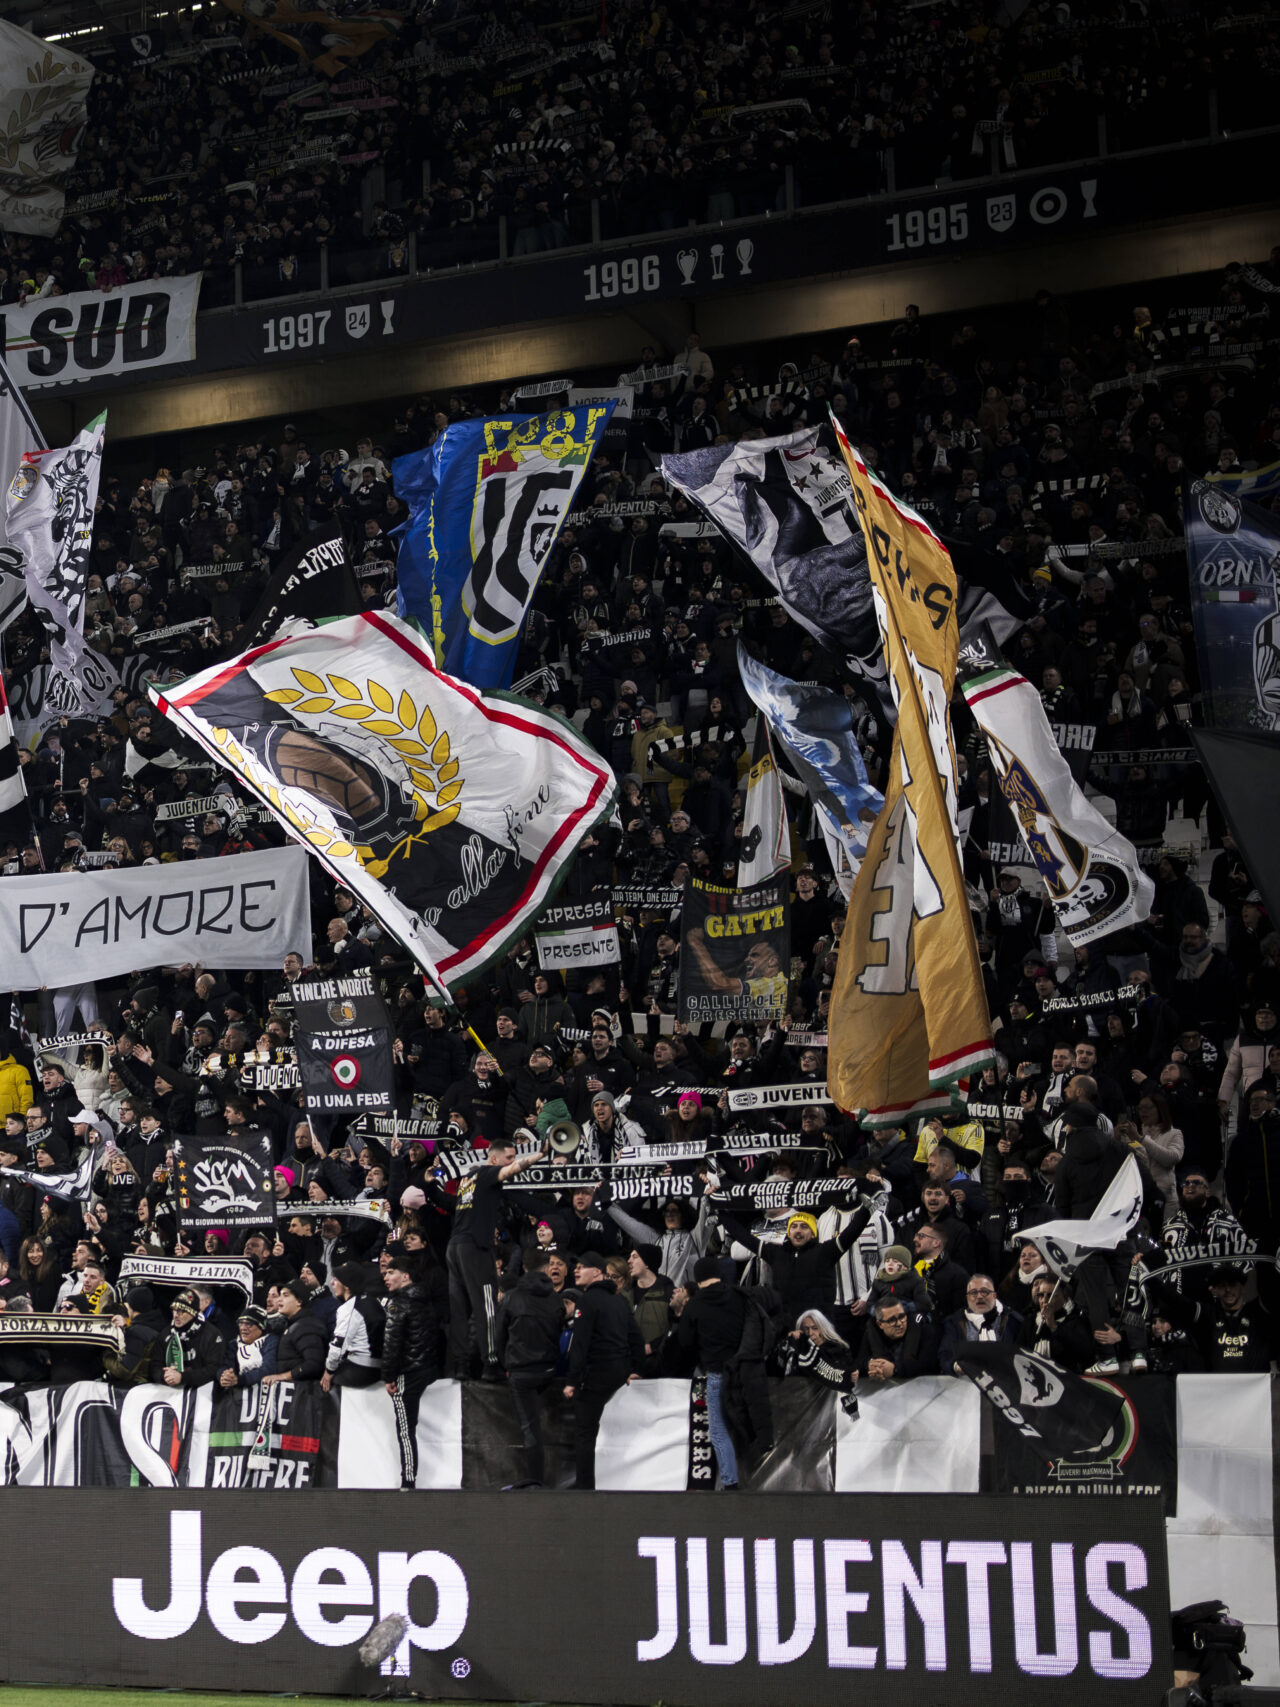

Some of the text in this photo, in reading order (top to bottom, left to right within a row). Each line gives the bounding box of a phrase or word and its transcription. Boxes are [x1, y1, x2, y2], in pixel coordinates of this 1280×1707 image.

[885, 202, 1014, 252] 1995 23
[584, 254, 660, 301] 1996
[26, 292, 171, 376] SUD
[263, 309, 368, 353] 1997 24
[814, 475, 851, 507] JUVENTUS
[602, 500, 655, 515] JUVENTUS
[821, 498, 861, 536] 7
[222, 561, 245, 573] JUVE
[1199, 559, 1255, 587] OBN
[1138, 750, 1190, 763] SIAMO
[164, 795, 218, 818] JUVENTUS
[446, 784, 551, 909] alla fine
[692, 877, 699, 888] IN
[623, 890, 679, 903] TEAM, ONE CLUB
[732, 887, 780, 909] LEONI
[19, 878, 277, 955] D'AMORE
[704, 906, 785, 938] GATTI
[542, 937, 616, 960] PRESENTE
[337, 977, 376, 997] MORTE
[686, 994, 785, 1010] GALLIPOLI
[689, 1010, 783, 1023] PRESENTE
[792, 1022, 811, 1032] 1897
[311, 1035, 376, 1051] A DIFESA
[306, 1091, 391, 1108] DI UNA FEDE
[373, 1117, 443, 1136] FINO ALLA FINE
[649, 1142, 679, 1158] FINO
[722, 1132, 801, 1149] JUVENTUS
[224, 1146, 241, 1156] OFFICIAL
[193, 1154, 257, 1190] SGM
[550, 1165, 604, 1181] ALLA
[609, 1175, 694, 1201] JUVENTUS
[730, 1176, 857, 1197] DI PADRE IN FIGLIO
[754, 1190, 823, 1209] SINCE 1897
[181, 1215, 274, 1227] SAN GIOVANNI IN MARIGNANO
[1165, 1237, 1259, 1264] JUVENTUS
[130, 1262, 241, 1279] MICHEL PLATINI
[1, 1317, 94, 1333] FORZA JUVE
[1218, 1333, 1249, 1348] Jeep
[814, 1356, 846, 1384] JUVENTUS
[974, 1369, 1043, 1439] 1897
[112, 1509, 470, 1678] Jeep
[637, 1537, 1153, 1679] JUVENTUS
